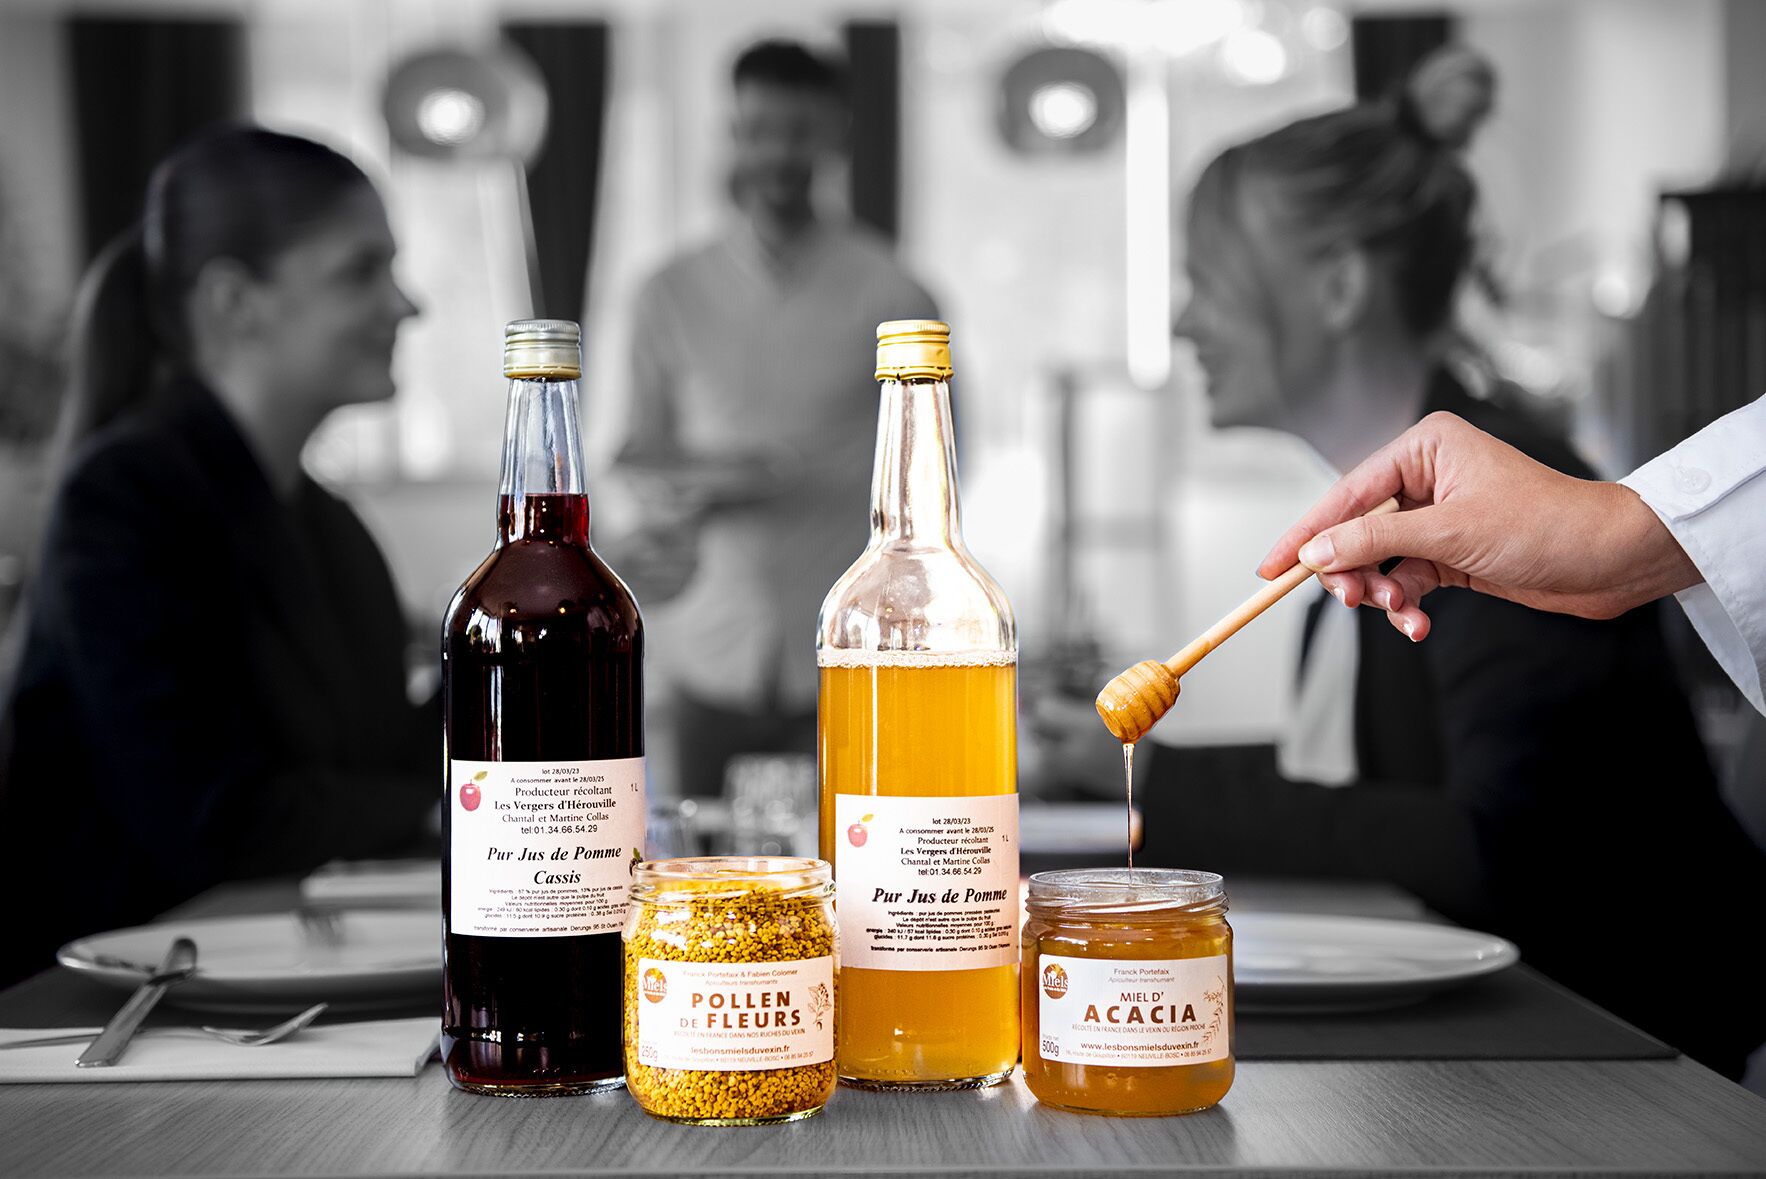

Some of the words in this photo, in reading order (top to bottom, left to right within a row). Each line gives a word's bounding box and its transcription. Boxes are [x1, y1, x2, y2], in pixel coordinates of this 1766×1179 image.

[515, 787, 570, 796] Producteur
[574, 786, 612, 796] récoltant
[494, 800, 510, 810] Les
[514, 801, 554, 813] Vergers
[558, 798, 616, 810] d'Hérouville
[502, 814, 534, 822] Chantal
[538, 814, 546, 822] et
[550, 814, 584, 822] Martine
[586, 812, 609, 822] Collas
[488, 846, 514, 860] Pur
[518, 847, 544, 861] Jus
[550, 847, 568, 860] de
[574, 846, 622, 860] Pomme
[917, 848, 948, 856] Vergers
[949, 846, 992, 854] d'Hérouville
[900, 858, 931, 866] Chantal
[972, 856, 990, 864] Collas
[534, 870, 582, 884] Cassis
[872, 888, 902, 903] Pur
[906, 888, 936, 904] Jus
[942, 888, 960, 904] de
[964, 888, 1008, 904] Pomme
[692, 991, 790, 1008] POLLEN
[1120, 992, 1148, 1002] MIEL
[1152, 992, 1164, 1002] D'
[680, 1018, 698, 1028] DE
[707, 1010, 800, 1028] FLEURS
[1084, 1004, 1197, 1024] ACACIA
[690, 1044, 790, 1055] lesbonsmielsduvexin.fr
[1042, 1040, 1060, 1057] 500g
[1081, 1041, 1200, 1052] www.lesbonsmielsduvexin.fr
